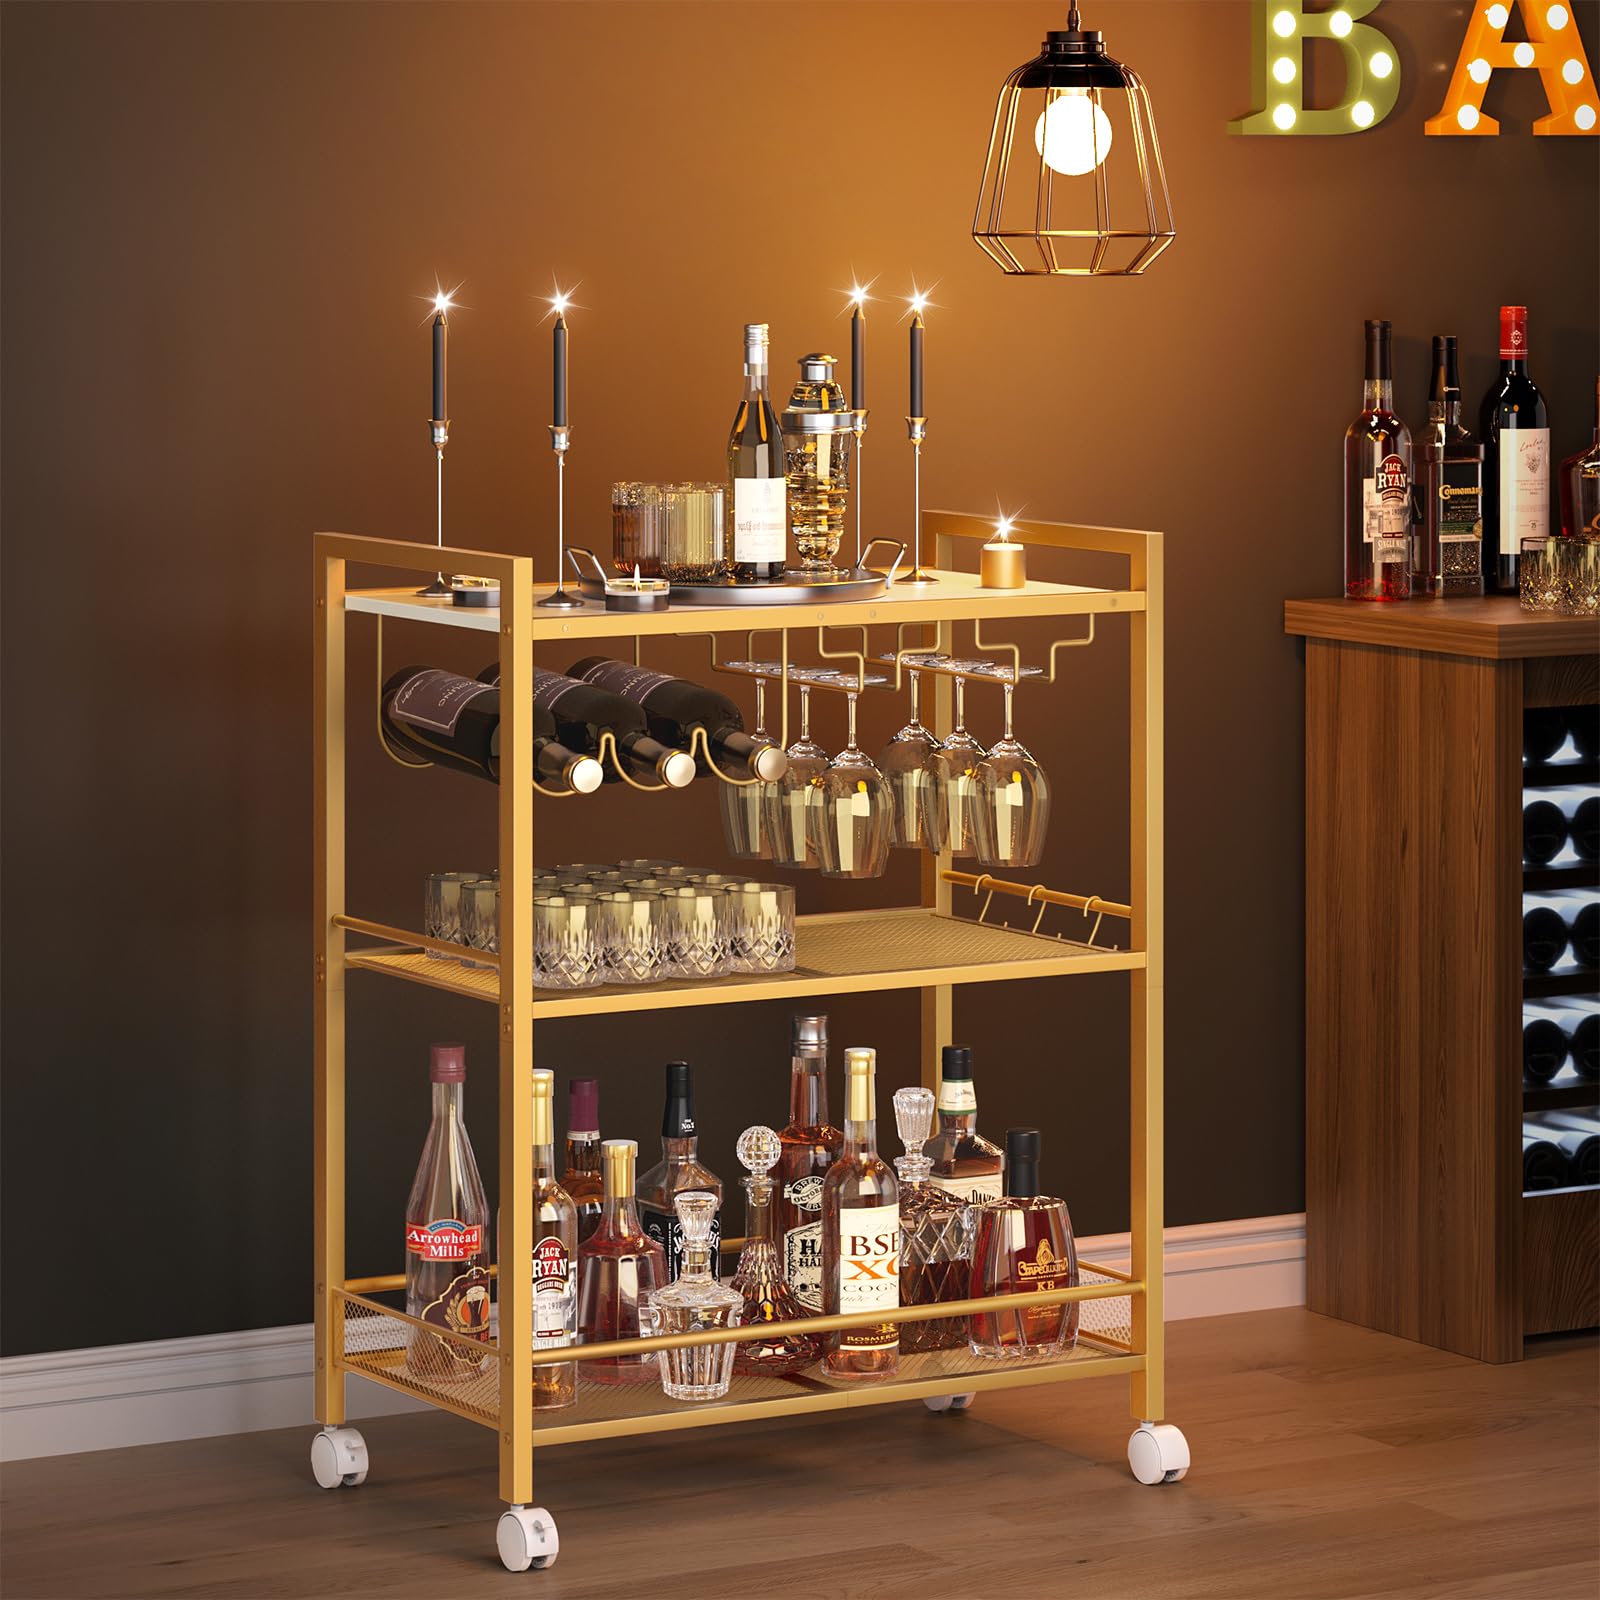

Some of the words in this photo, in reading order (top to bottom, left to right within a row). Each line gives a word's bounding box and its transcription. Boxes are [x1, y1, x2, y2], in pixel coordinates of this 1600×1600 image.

[1384, 463, 1401, 472] JACK
[1377, 473, 1407, 489] RYAN
[407, 1230, 478, 1244] Arrowhead
[430, 1245, 464, 1257] Mills
[540, 1247, 560, 1259] JACK
[532, 1259, 568, 1279] RYAN
